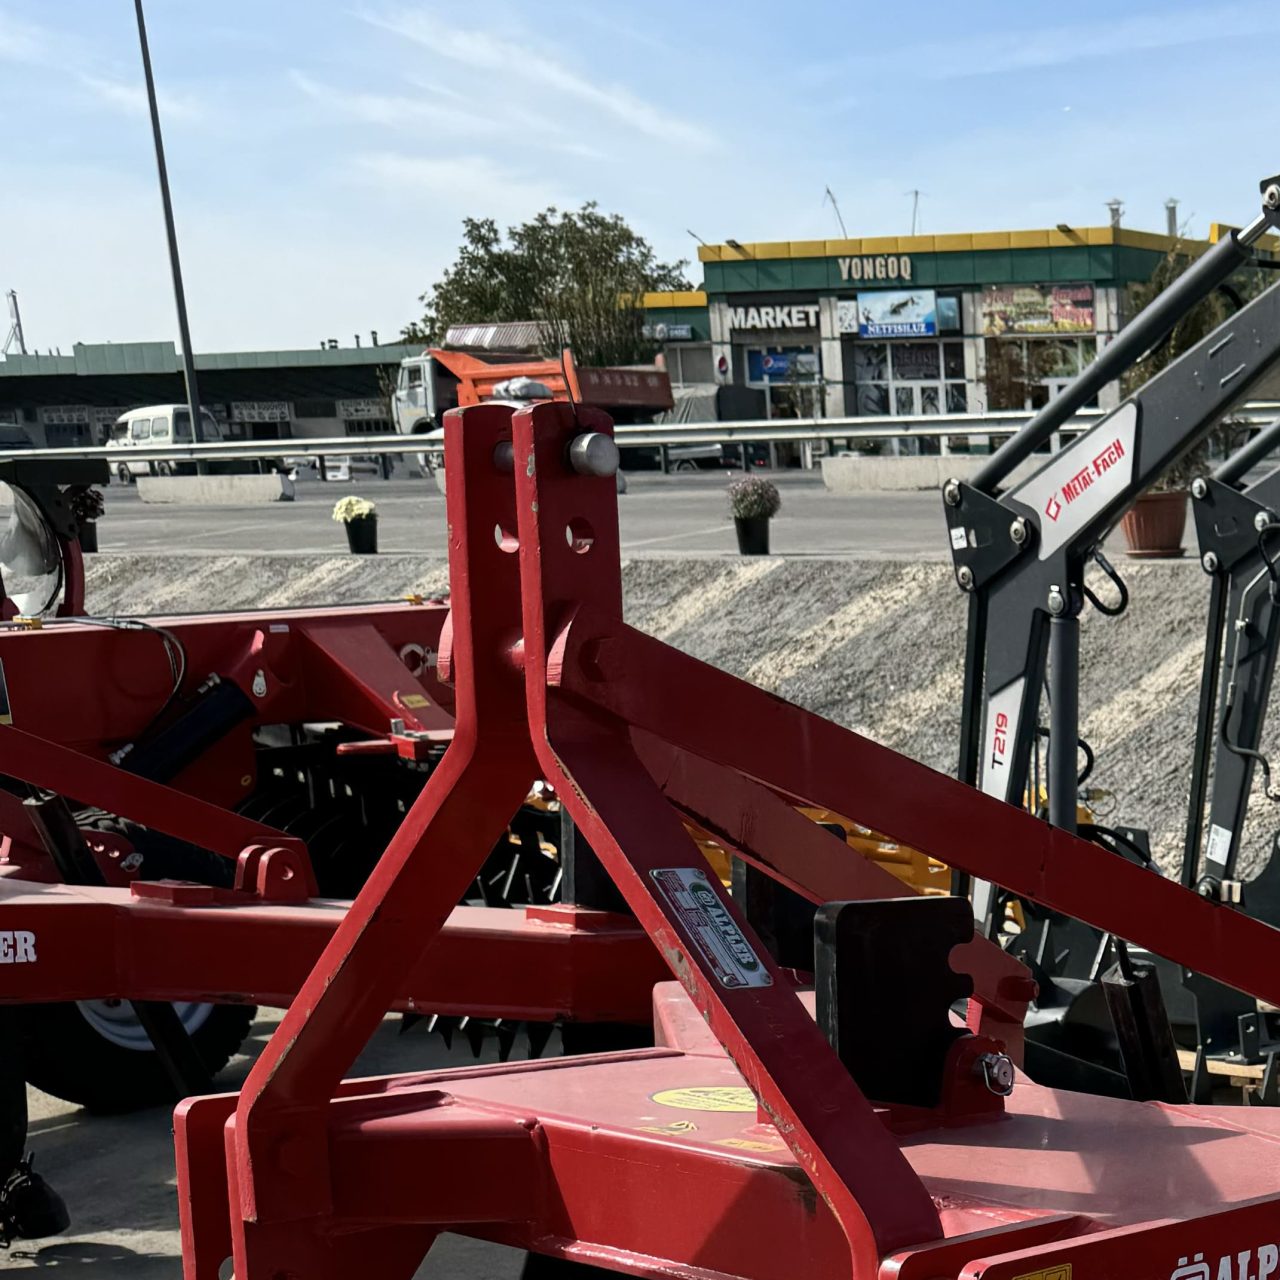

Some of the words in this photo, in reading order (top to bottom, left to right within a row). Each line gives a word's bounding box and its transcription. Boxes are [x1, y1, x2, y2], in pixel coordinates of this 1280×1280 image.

[728, 305, 820, 330] MARKET
[1061, 438, 1125, 504] METAL-FACH
[991, 712, 1008, 770] T219
